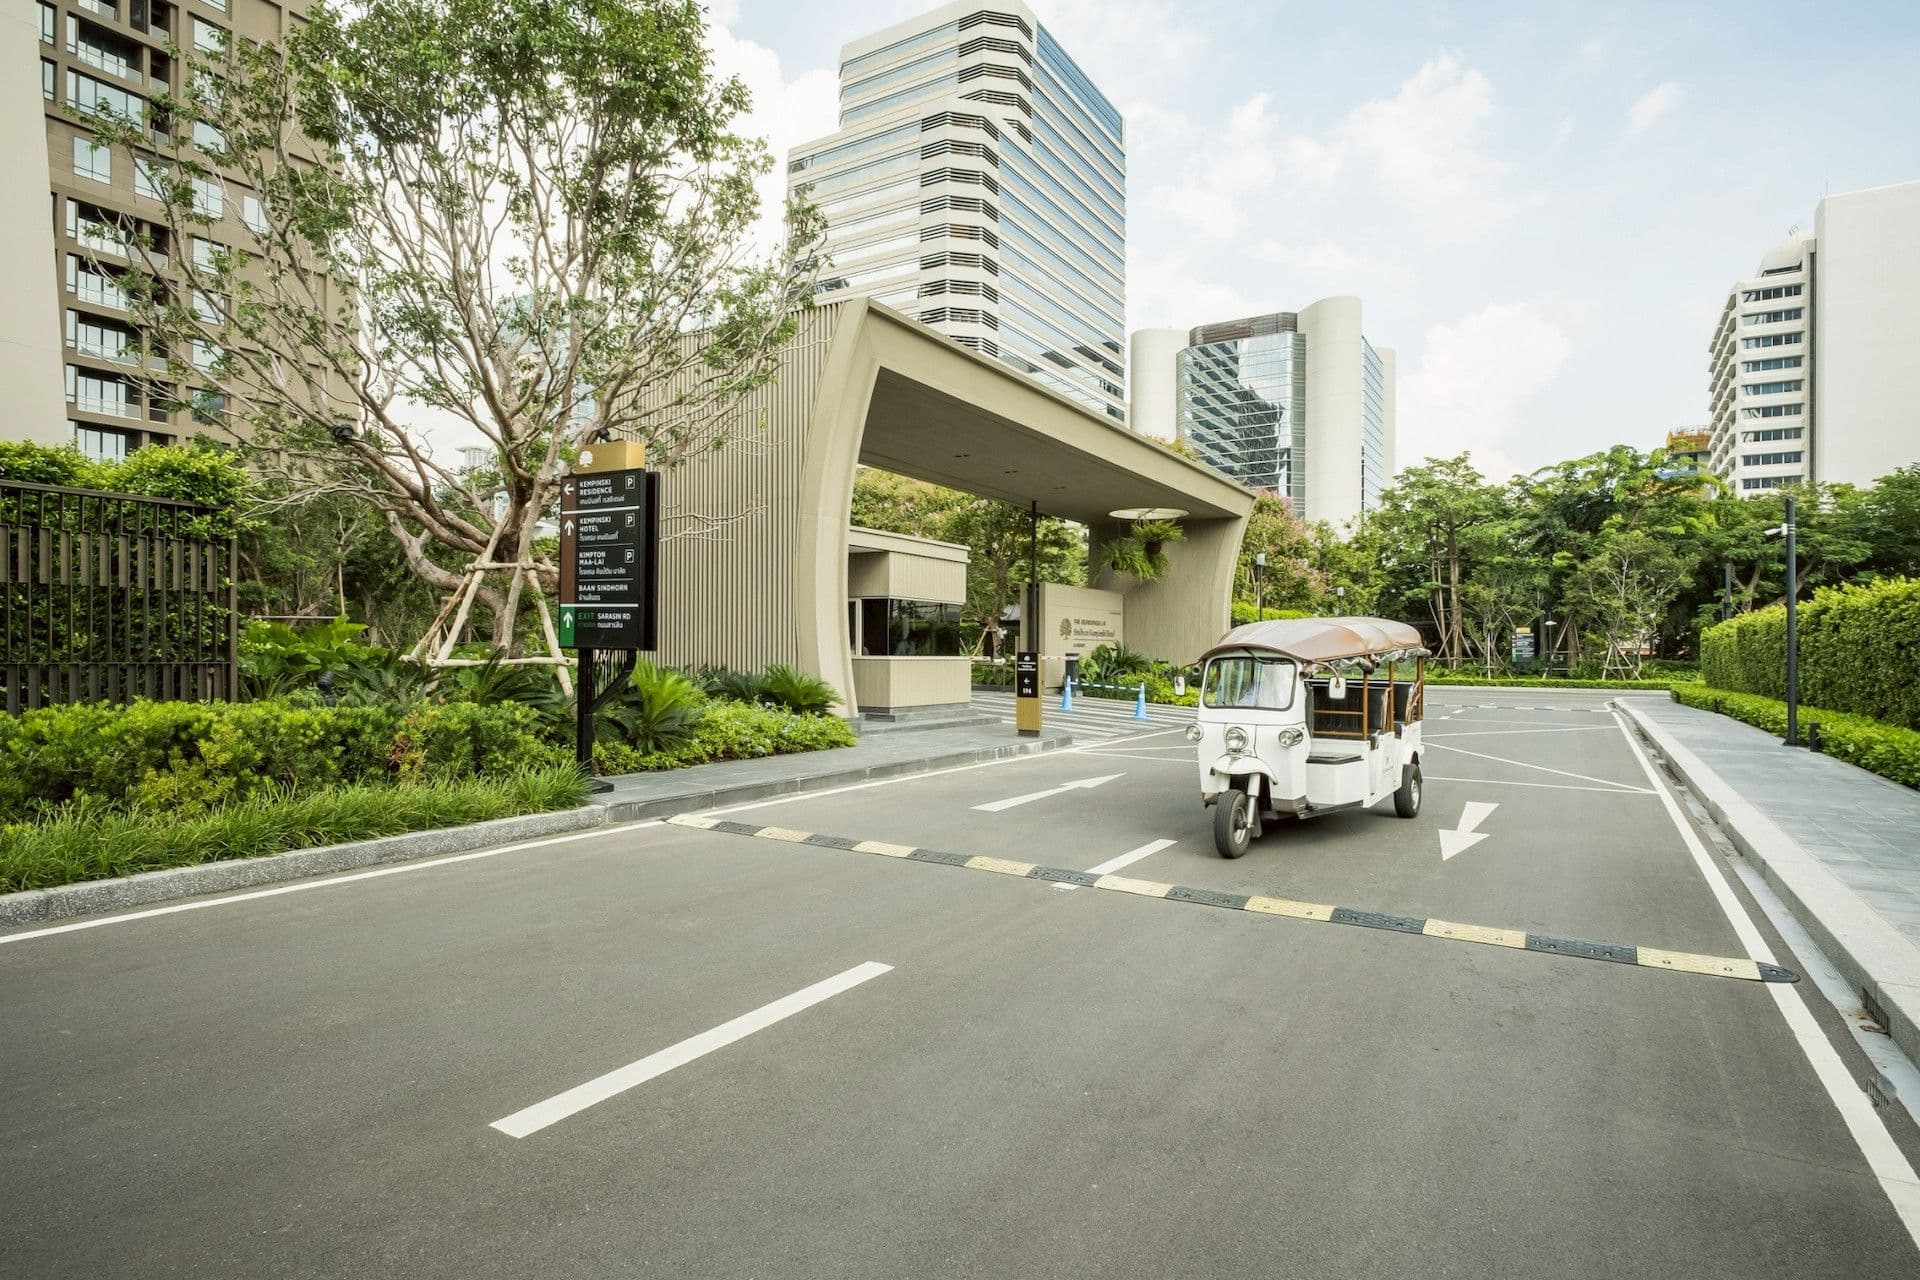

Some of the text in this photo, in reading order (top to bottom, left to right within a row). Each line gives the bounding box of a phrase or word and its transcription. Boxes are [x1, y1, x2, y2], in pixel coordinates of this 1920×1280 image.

[580, 479, 611, 488] KEMPINSKI
[580, 487, 612, 496] RESIDENCE
[580, 516, 611, 524] KEMPINSKI
[579, 551, 606, 559] KIMPTON
[626, 552, 633, 560] P
[579, 584, 596, 592] BAAN
